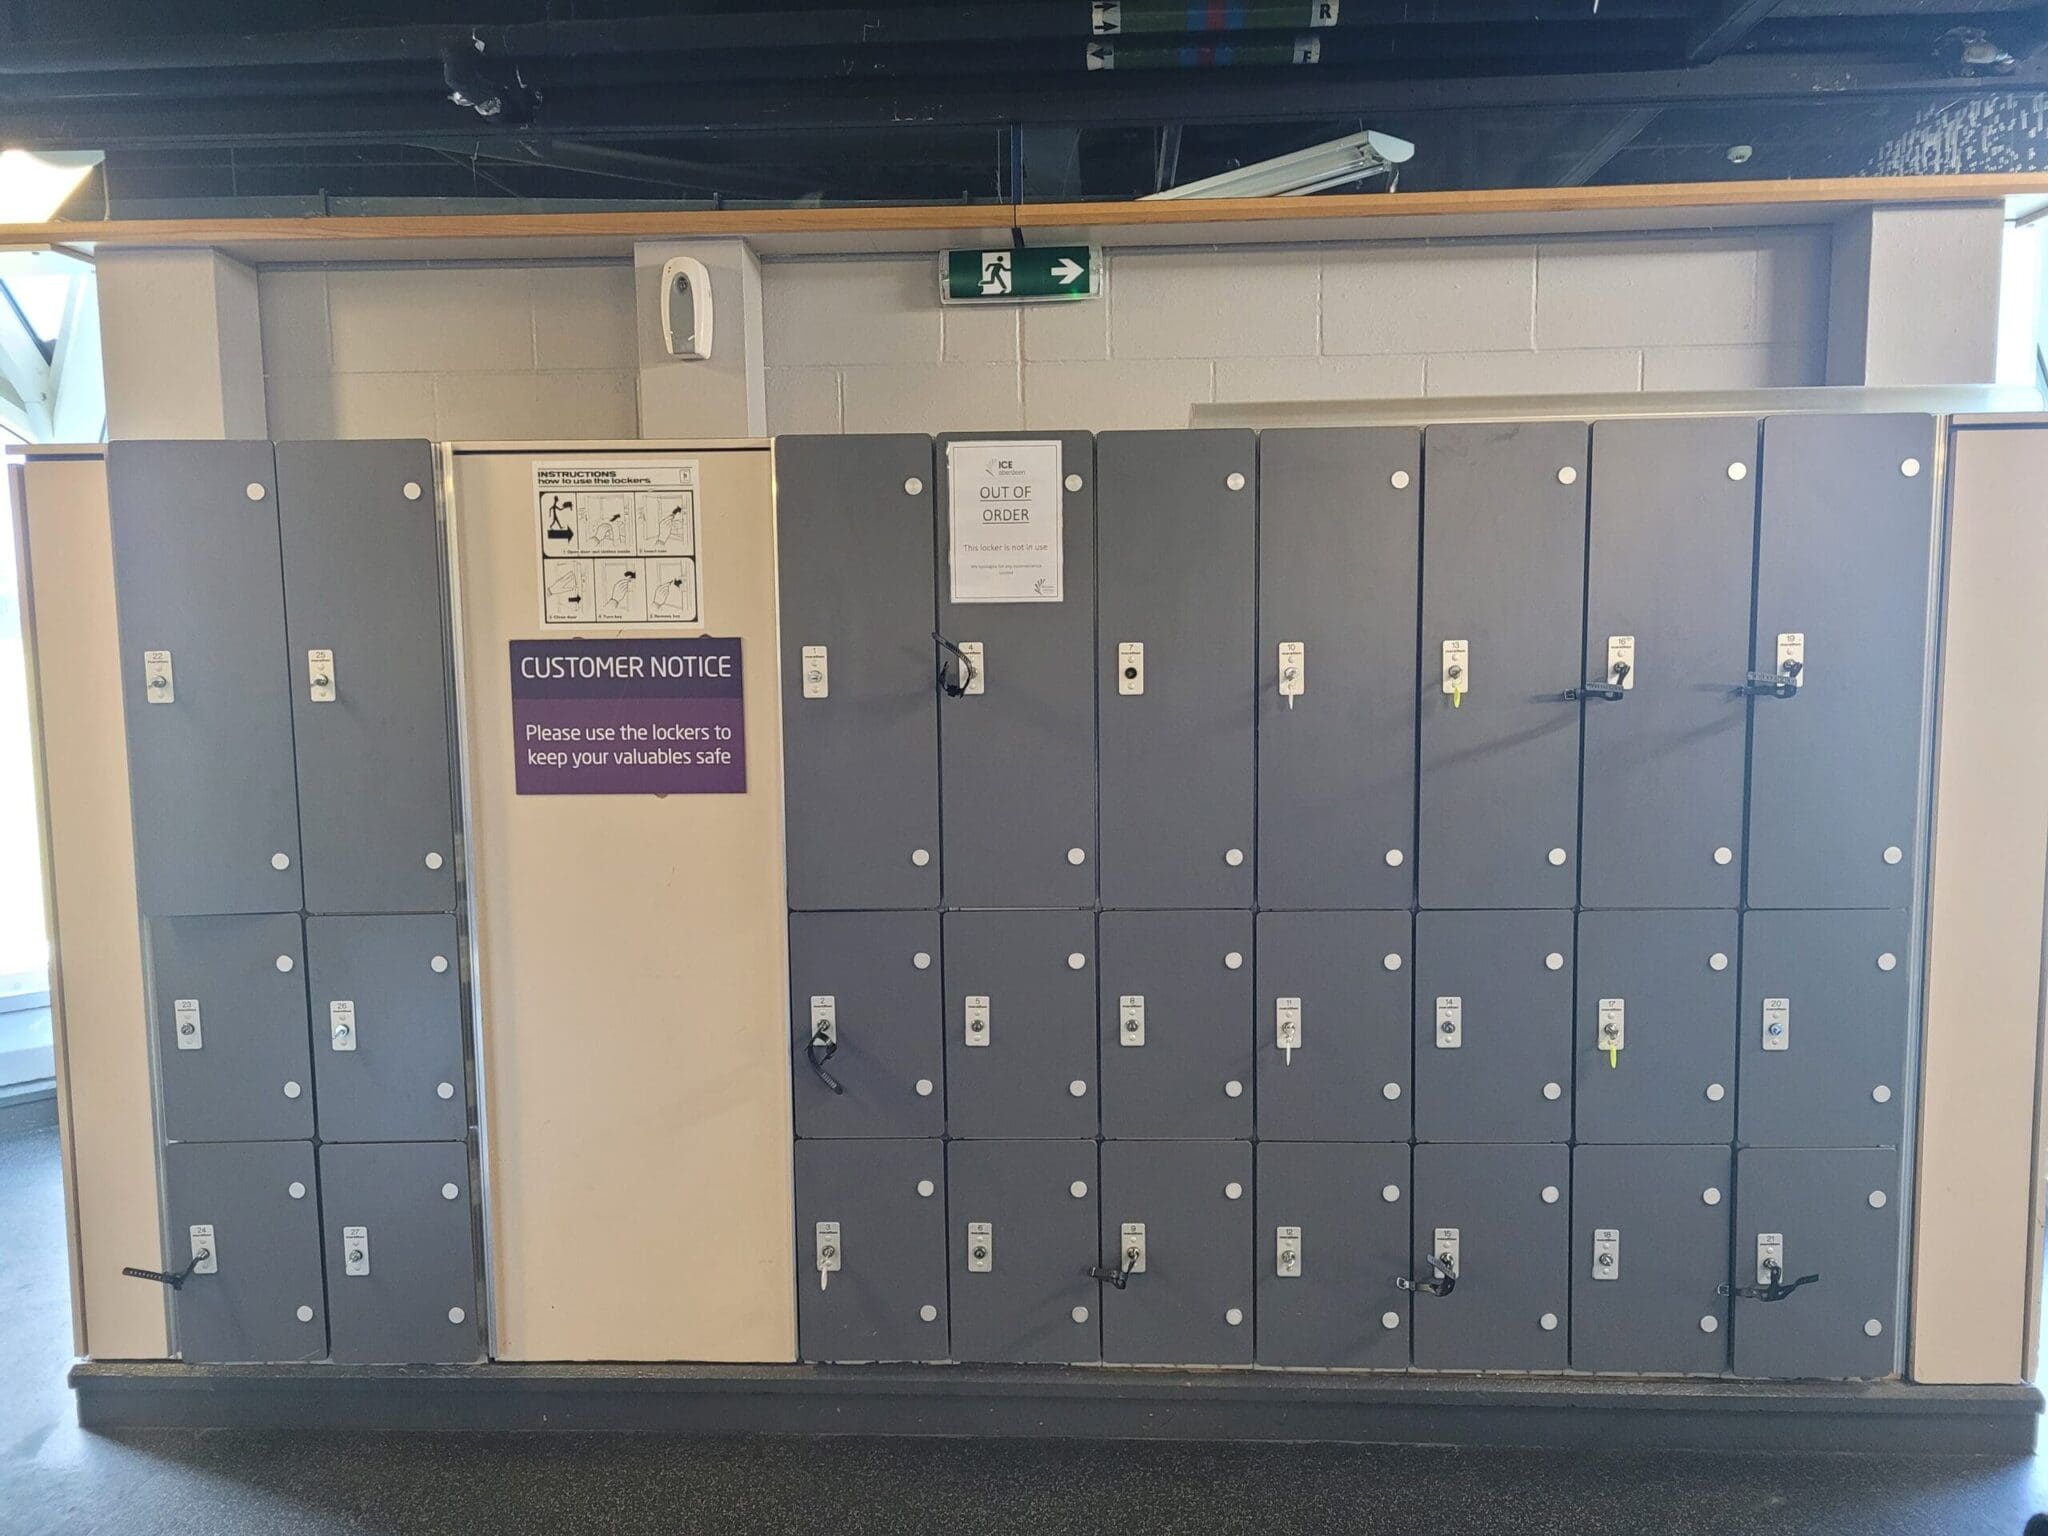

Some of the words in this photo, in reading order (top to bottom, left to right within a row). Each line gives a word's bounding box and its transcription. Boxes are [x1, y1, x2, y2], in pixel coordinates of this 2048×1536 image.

[1319, 4, 1331, 19] R
[998, 461, 1013, 469] ICE
[980, 486, 1009, 499] OUT
[1013, 486, 1032, 499] OF
[983, 509, 1030, 522] ORDER
[980, 544, 1003, 552] locker
[1287, 643, 1296, 651] 10
[1451, 641, 1460, 649] 13
[152, 652, 163, 660] 22
[316, 651, 326, 659] 25
[520, 656, 645, 679] CUSTOMER
[650, 655, 732, 678] NOTICE
[526, 724, 581, 741] Please
[586, 727, 615, 741] use
[619, 724, 648, 740] the
[652, 723, 710, 740] lockers
[715, 725, 732, 740] to
[528, 748, 568, 768] keep
[572, 750, 609, 769] your
[613, 748, 691, 765] valuables
[696, 748, 732, 765] safe
